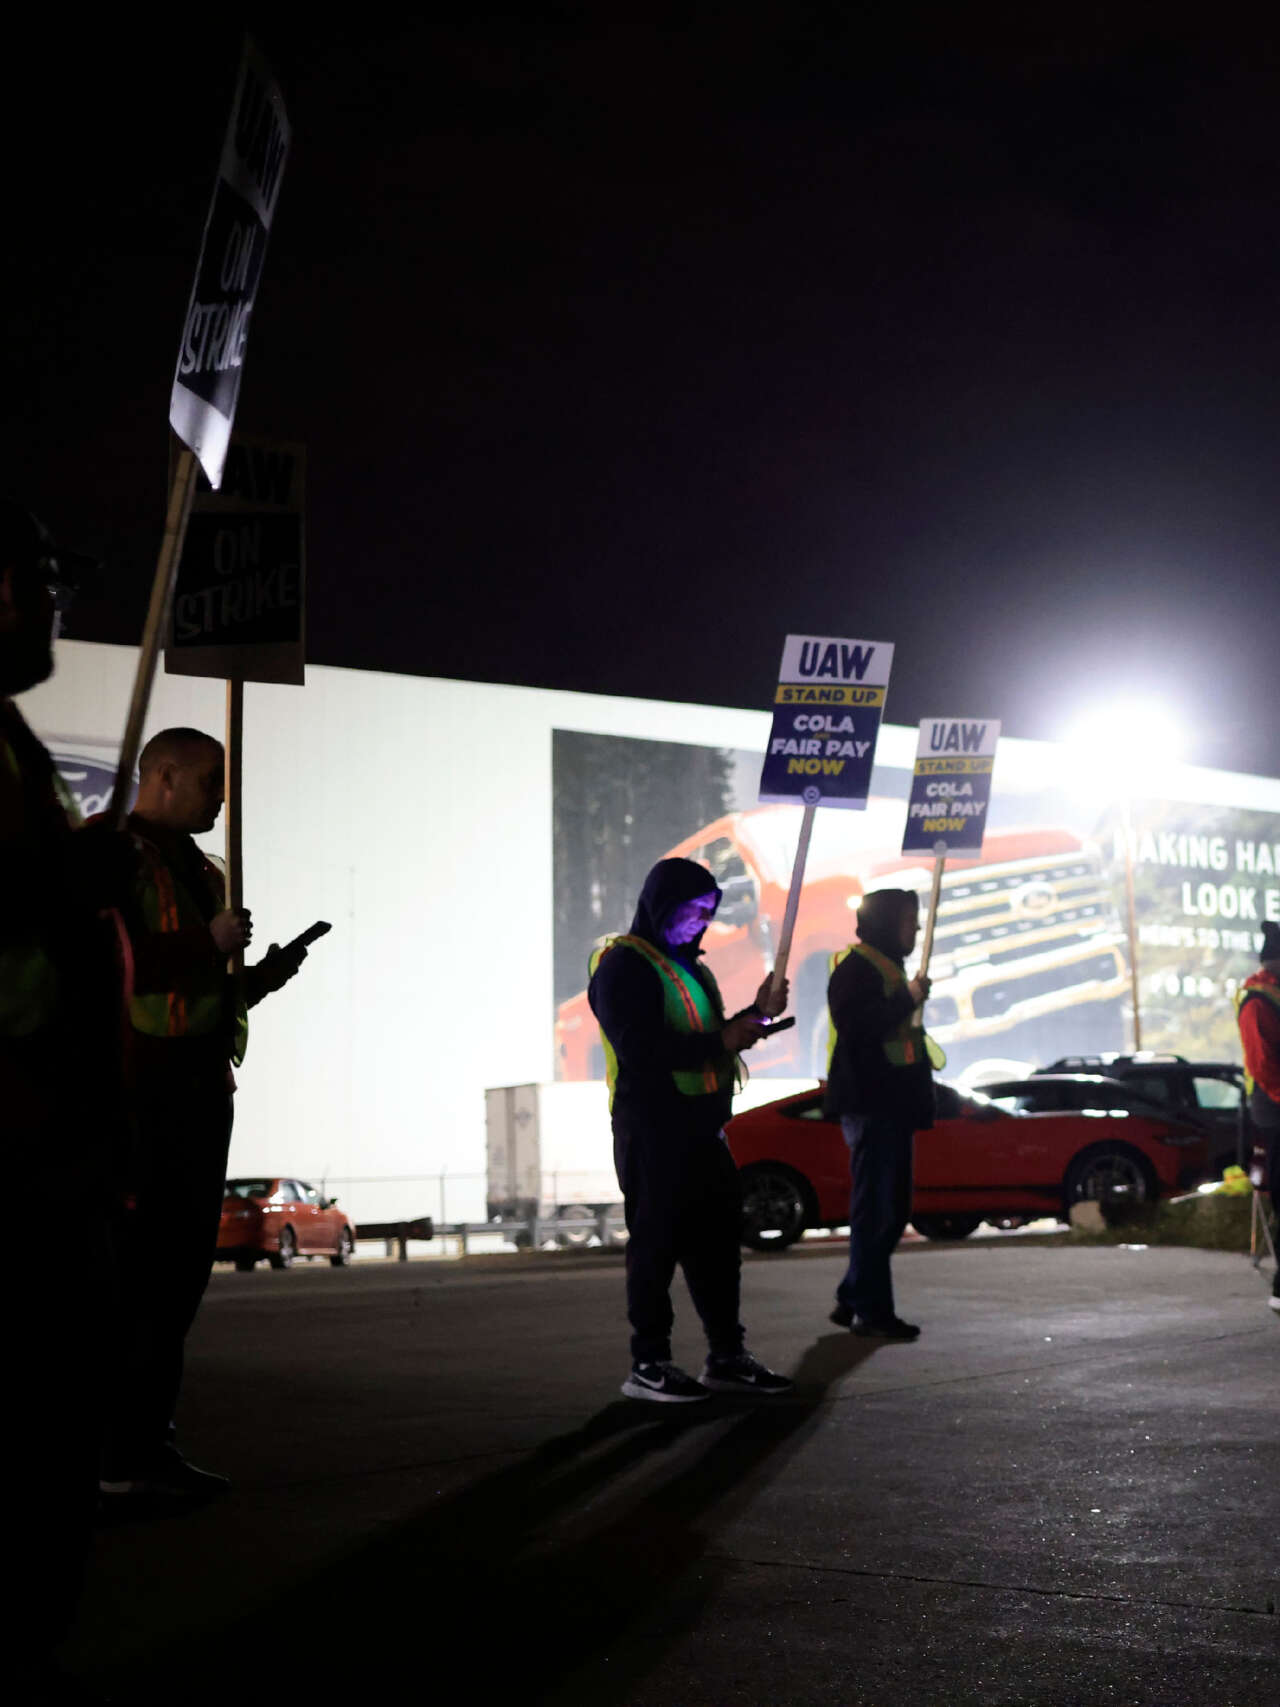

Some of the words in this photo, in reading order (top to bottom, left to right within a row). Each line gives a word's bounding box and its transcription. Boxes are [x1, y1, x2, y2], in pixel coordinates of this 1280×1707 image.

[220, 218, 258, 293] ON
[214, 518, 264, 576] ON
[175, 561, 299, 641] STRIKE
[799, 641, 876, 681] UAW
[782, 688, 846, 703] STAND
[851, 690, 878, 704] UP
[793, 714, 856, 733] COLA
[930, 723, 987, 753] UAW
[770, 738, 823, 757] FAIR
[824, 740, 871, 759] PAY
[787, 758, 846, 776] NOW
[918, 760, 967, 774] STAND
[926, 782, 973, 798] COLA
[910, 802, 949, 819] FAIR
[950, 801, 987, 817] PAY
[923, 816, 967, 833] NOW
[1182, 881, 1258, 920] LOOK
